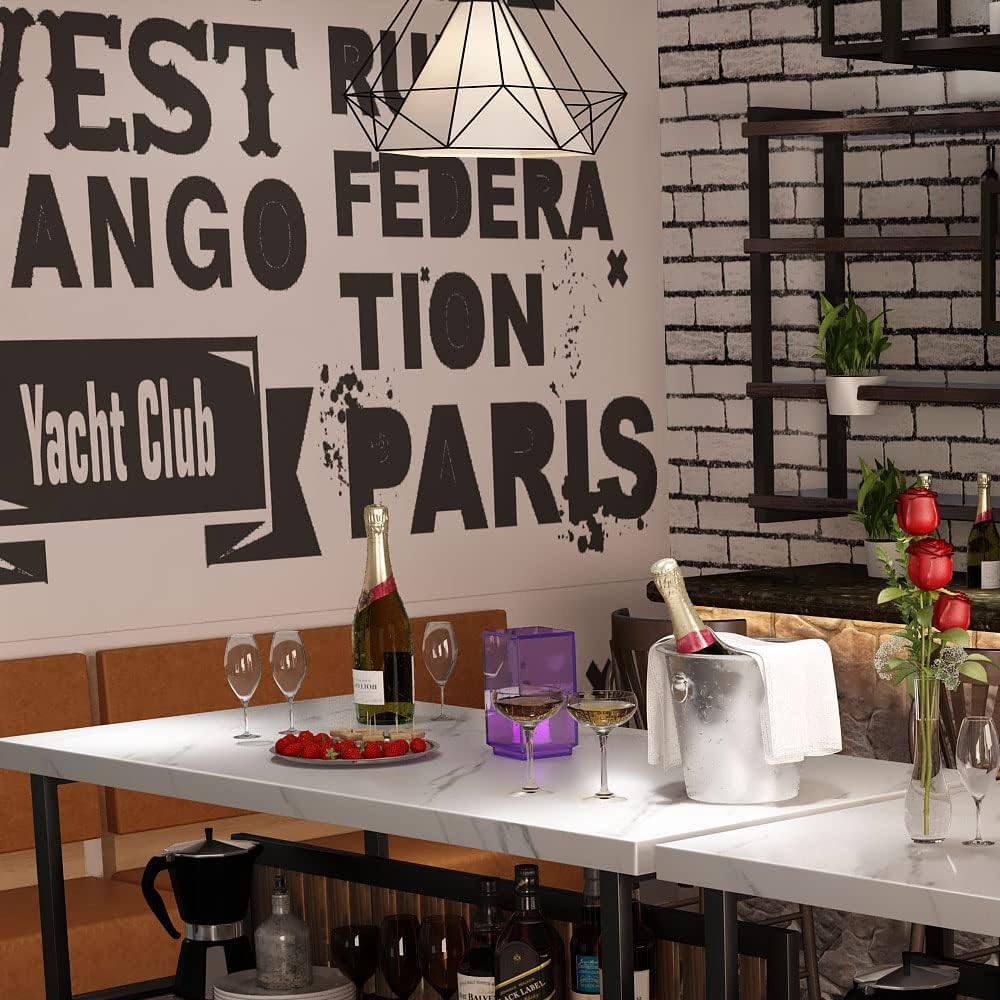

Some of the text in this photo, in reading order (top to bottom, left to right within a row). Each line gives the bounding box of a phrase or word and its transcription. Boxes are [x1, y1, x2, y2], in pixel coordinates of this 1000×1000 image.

[11, 174, 307, 291] ANGO
[333, 150, 614, 241] FEDERA
[339, 271, 545, 371] TION
[19, 377, 216, 486] Yacht Club
[346, 396, 658, 540] PARIS
[520, 980, 546, 995] LABEL
